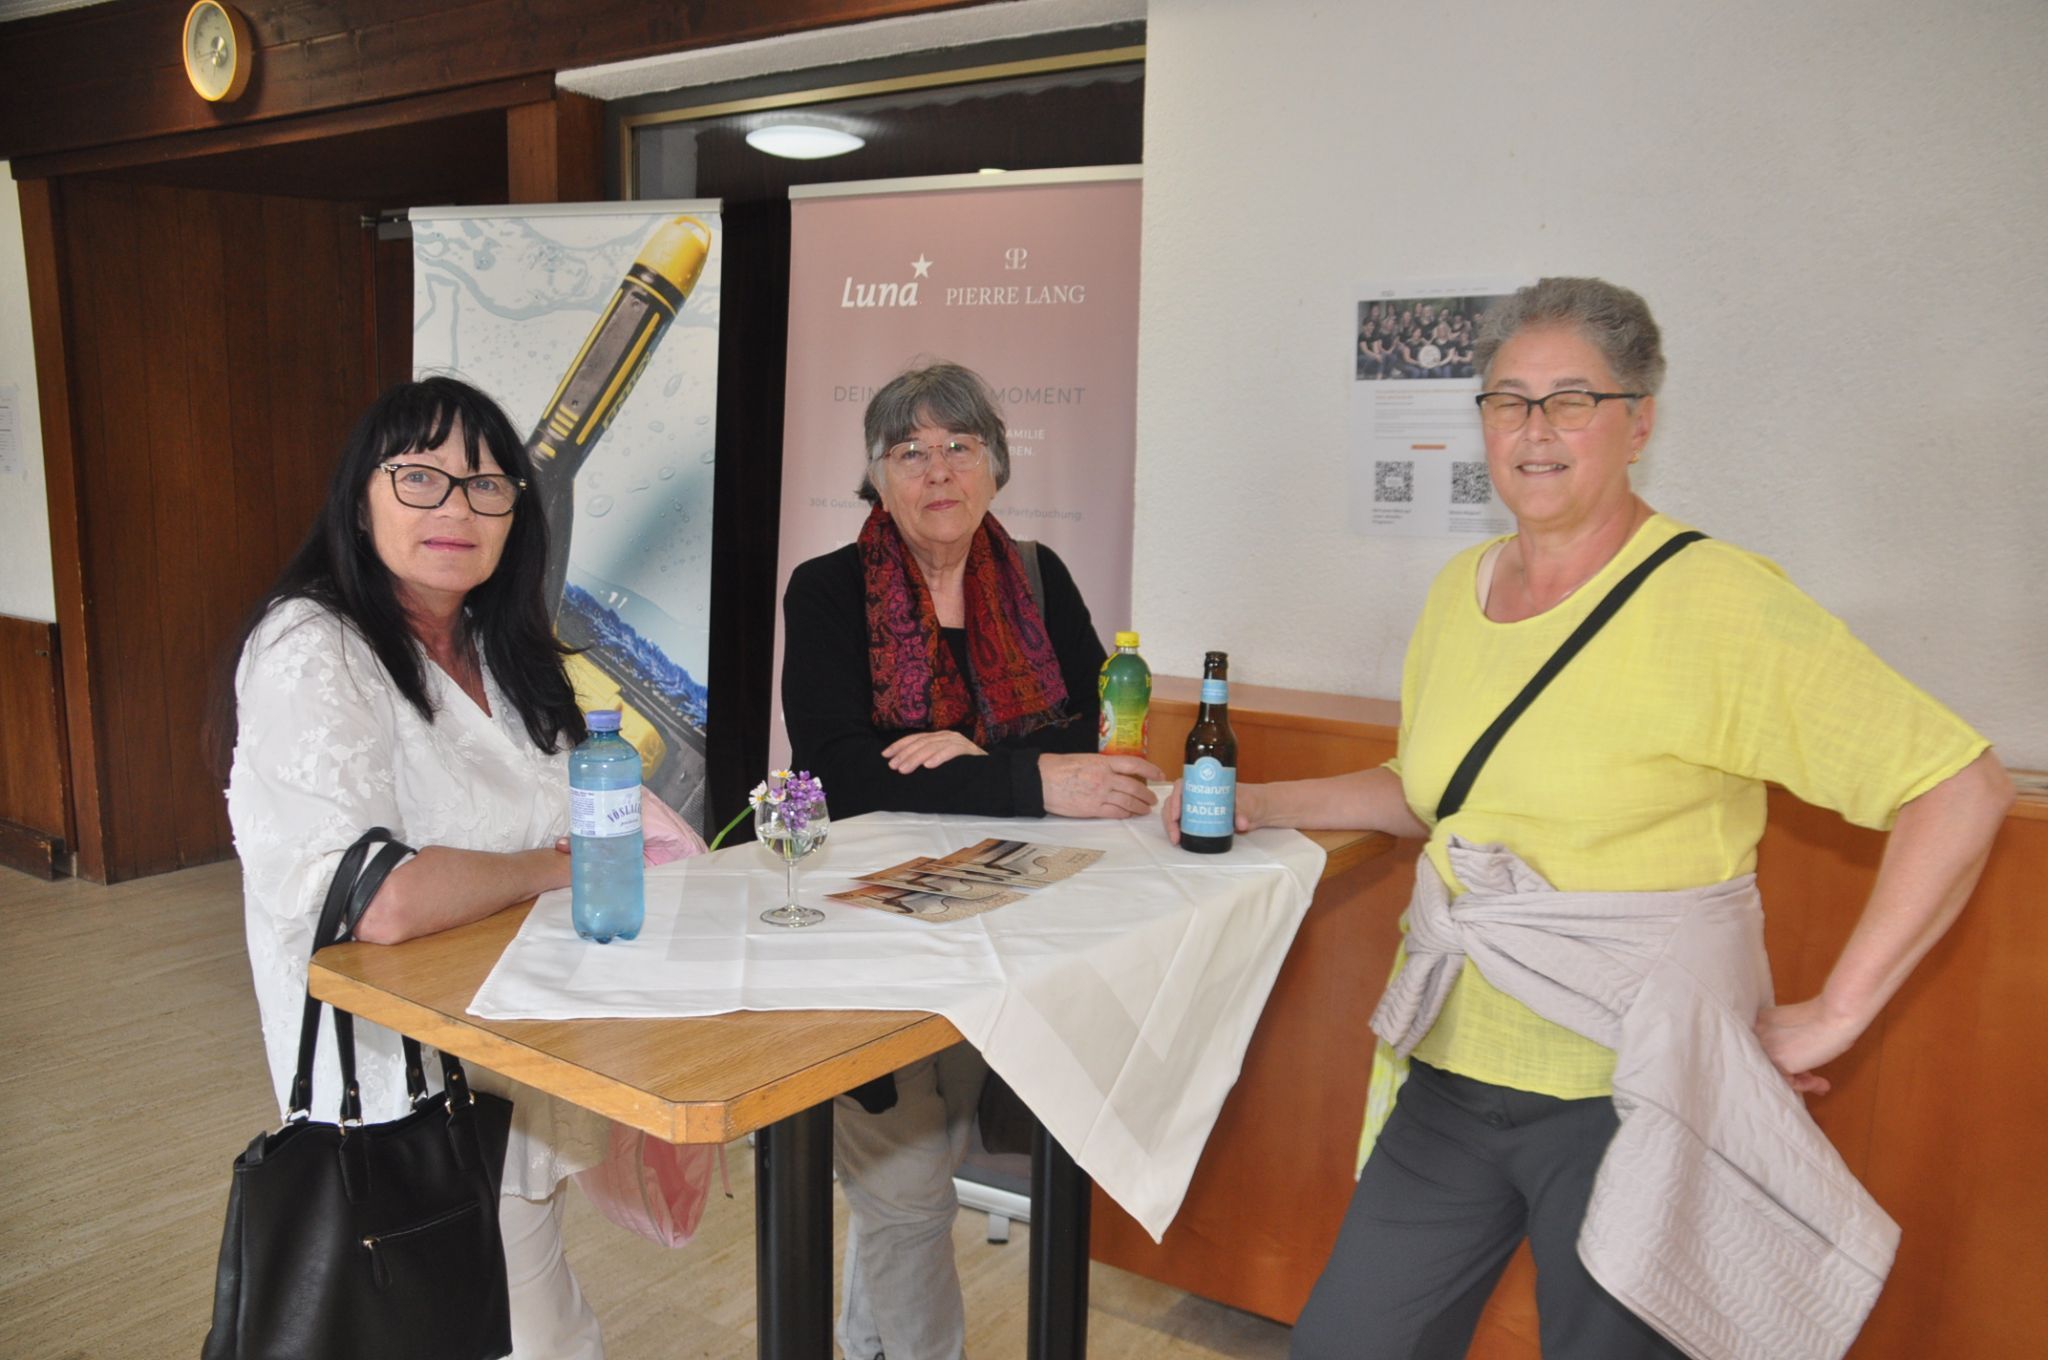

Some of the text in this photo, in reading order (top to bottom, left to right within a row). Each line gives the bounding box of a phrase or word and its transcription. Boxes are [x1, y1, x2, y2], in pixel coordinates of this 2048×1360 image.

[841, 277, 918, 307] Luna
[945, 284, 1085, 306] PIERRE LANG
[991, 386, 1085, 405] MOMENT
[1005, 429, 1045, 440] AMILIE
[1186, 804, 1227, 816] RADLER
